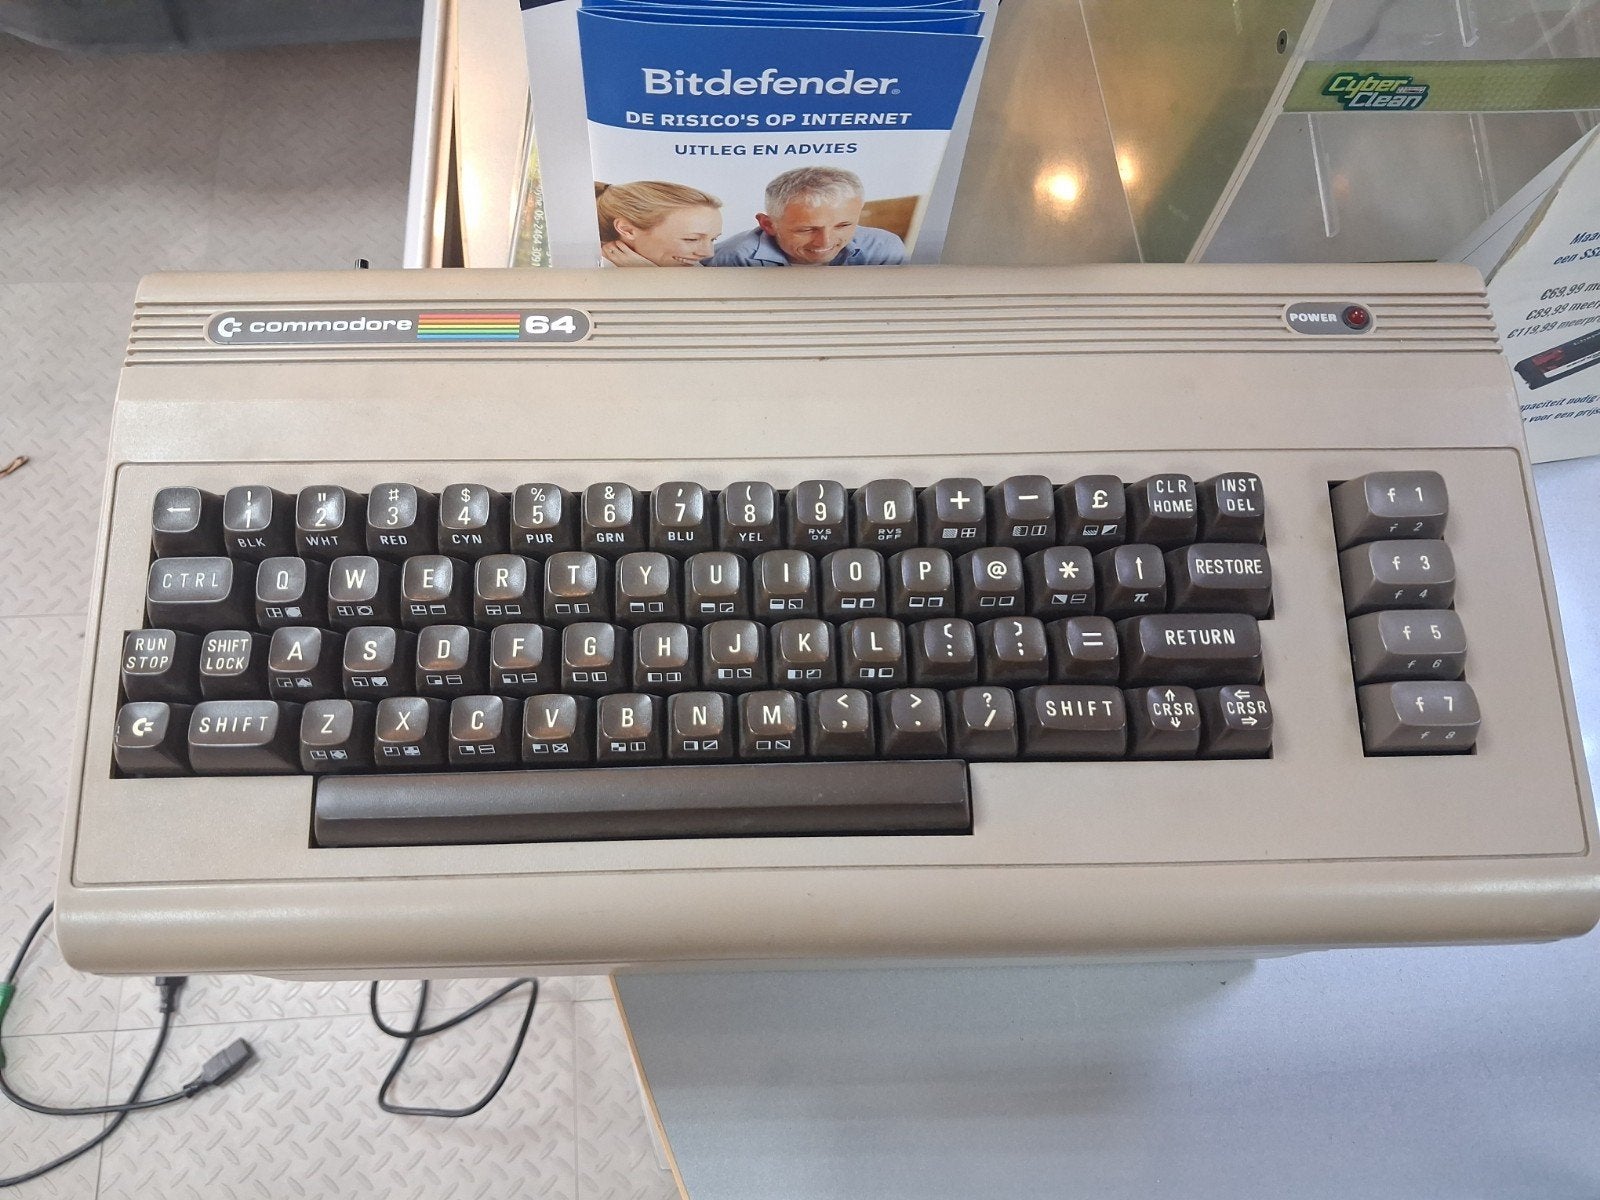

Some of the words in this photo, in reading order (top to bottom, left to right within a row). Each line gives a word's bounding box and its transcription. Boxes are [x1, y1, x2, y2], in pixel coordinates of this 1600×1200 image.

[641, 68, 898, 96] Bitdefender
[1328, 76, 1409, 99] Cyber
[1348, 92, 1423, 107] Clean
[626, 111, 654, 125] DE
[661, 114, 759, 127] RISICO'S
[766, 114, 796, 126] OP
[802, 112, 912, 126] INTERNET
[675, 144, 746, 156] UITLEG
[753, 144, 778, 155] EN
[784, 142, 858, 154] ADVIES
[1553, 253, 1579, 265] een
[1540, 282, 1586, 301] €69,99
[1289, 313, 1337, 322] POWER
[1525, 302, 1570, 321] €89,99
[249, 318, 413, 333] commodore
[525, 315, 576, 334] 64
[1506, 321, 1559, 339] €119,99
[1529, 413, 1553, 423] voor
[1554, 411, 1575, 419] een
[1156, 479, 1187, 493] CLR
[1221, 478, 1257, 492] INST
[1092, 489, 1108, 509] £
[1154, 499, 1193, 513] HOME
[1227, 499, 1255, 511] DEL
[244, 509, 252, 528] 1
[315, 508, 327, 527] 2
[386, 507, 399, 525] 3
[457, 506, 470, 525] 4
[532, 506, 544, 524] 5
[604, 504, 616, 523] 6
[674, 503, 686, 522] 7
[744, 504, 757, 523] 8
[814, 502, 827, 521] 9
[237, 537, 266, 548] BLK
[305, 535, 339, 547] WHT
[379, 535, 407, 545] RED
[452, 534, 482, 544] CYN
[526, 533, 554, 543] PUR
[596, 532, 625, 543] GRN
[668, 531, 694, 541] BLU
[739, 532, 763, 542] YEL
[567, 565, 580, 585] T
[639, 566, 652, 585] Y
[710, 565, 722, 584] U
[783, 562, 789, 583] I
[850, 561, 862, 581] O
[919, 561, 931, 580] P
[987, 560, 1007, 579] @
[1195, 558, 1263, 575] RESTORE
[163, 573, 219, 588] CTRL
[276, 570, 289, 590] Q
[345, 569, 366, 589] W
[423, 569, 434, 588] E
[496, 568, 509, 588] R
[135, 638, 167, 651] RUN
[207, 639, 249, 652] SHIFT
[584, 637, 597, 656] G
[658, 637, 671, 656] H
[728, 633, 741, 653] J
[799, 632, 812, 652] K
[870, 631, 883, 650] L
[1165, 629, 1235, 645] RETURN
[287, 641, 303, 661] A
[363, 641, 377, 661] S
[437, 639, 450, 659] D
[512, 638, 524, 657] F
[126, 656, 168, 669] STOP
[206, 657, 244, 670] LOCK
[621, 707, 634, 727] B
[693, 706, 707, 725] N
[762, 705, 782, 725] M
[1045, 700, 1113, 717] SHIFT
[1153, 703, 1195, 715] CRSR
[1226, 701, 1268, 714] CRSR
[199, 715, 269, 733] SHIFT
[320, 714, 335, 734] Z
[395, 711, 411, 730] X
[471, 710, 484, 730] C
[545, 708, 559, 728] V
